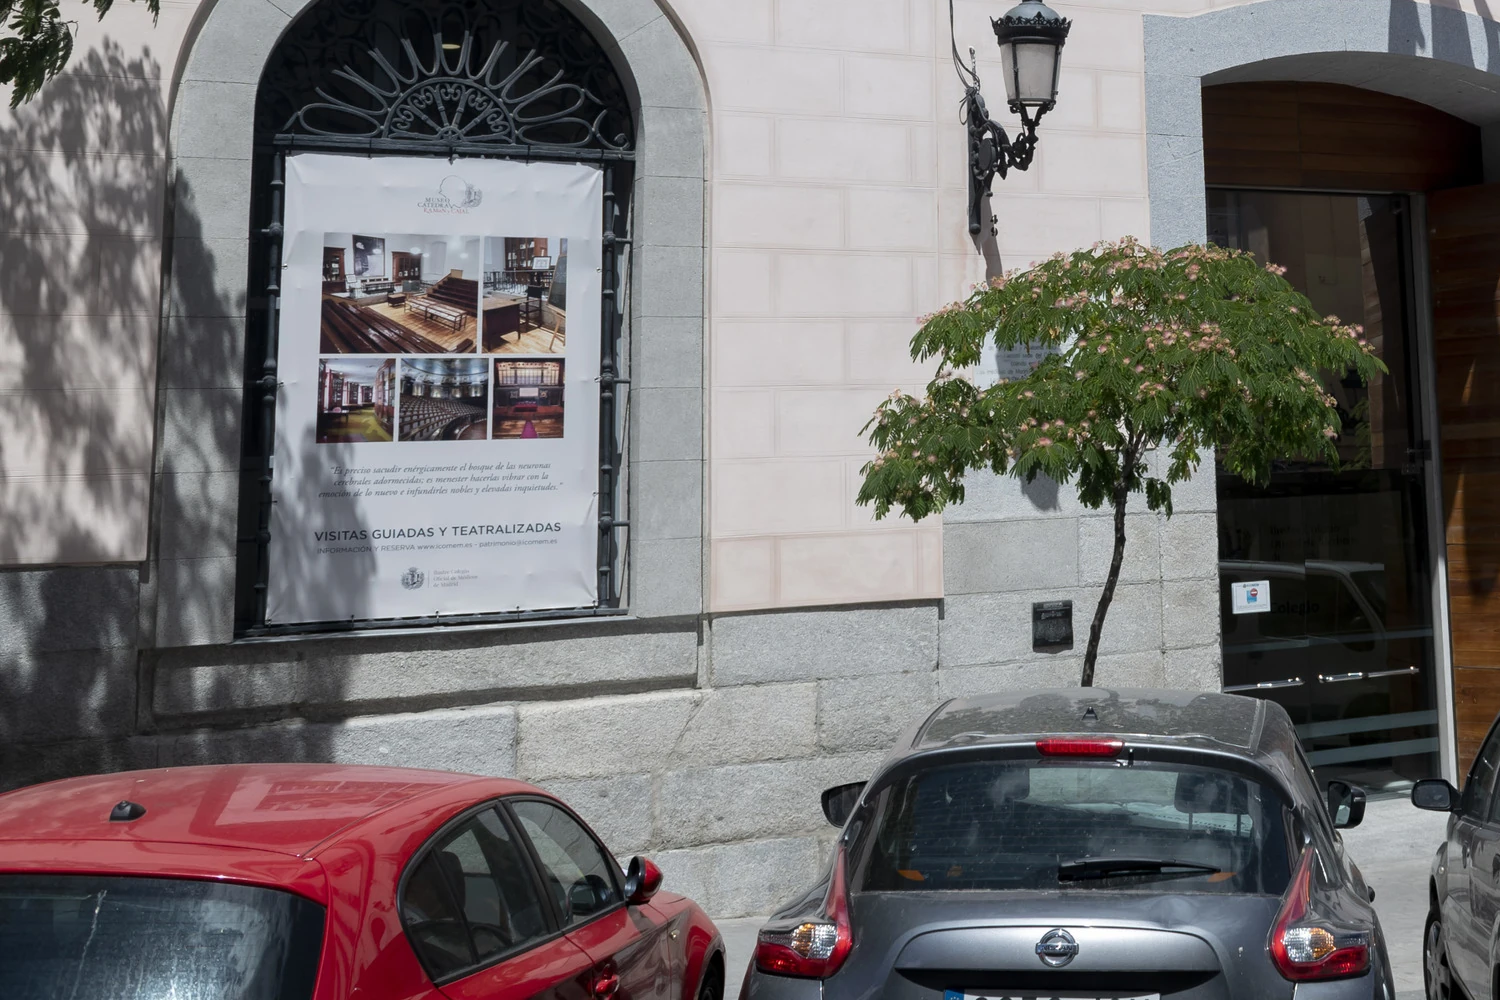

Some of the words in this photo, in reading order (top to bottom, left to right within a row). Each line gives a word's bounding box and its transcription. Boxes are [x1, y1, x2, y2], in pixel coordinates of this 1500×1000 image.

[344, 467, 371, 476] preciso
[372, 465, 402, 474] sacudir
[403, 464, 458, 474] enérgicamente
[460, 463, 466, 471] el
[468, 463, 494, 473] bosque
[495, 462, 505, 471] de
[506, 462, 516, 470] las
[334, 477, 371, 486] cerebrales
[435, 475, 469, 483] menester
[470, 474, 499, 482] hacerlas
[502, 473, 525, 481] vibrar
[541, 472, 549, 480] la
[318, 489, 351, 498] emoción
[353, 488, 363, 497] de
[364, 488, 373, 497] lo
[406, 487, 448, 498] infundirles
[451, 485, 473, 494] nobles
[475, 487, 481, 495] y
[481, 484, 512, 493] elevadas
[314, 530, 368, 541] VISITAS
[372, 528, 435, 540] GUIADAS
[439, 527, 448, 537] Y
[451, 522, 562, 537] TEATRALIZADAS
[316, 545, 372, 555] INFORMACIÓN
[381, 544, 415, 552] RESERVA
[417, 542, 473, 550] www.icomem.es
[478, 538, 558, 548] patrimonio@icomem.es
